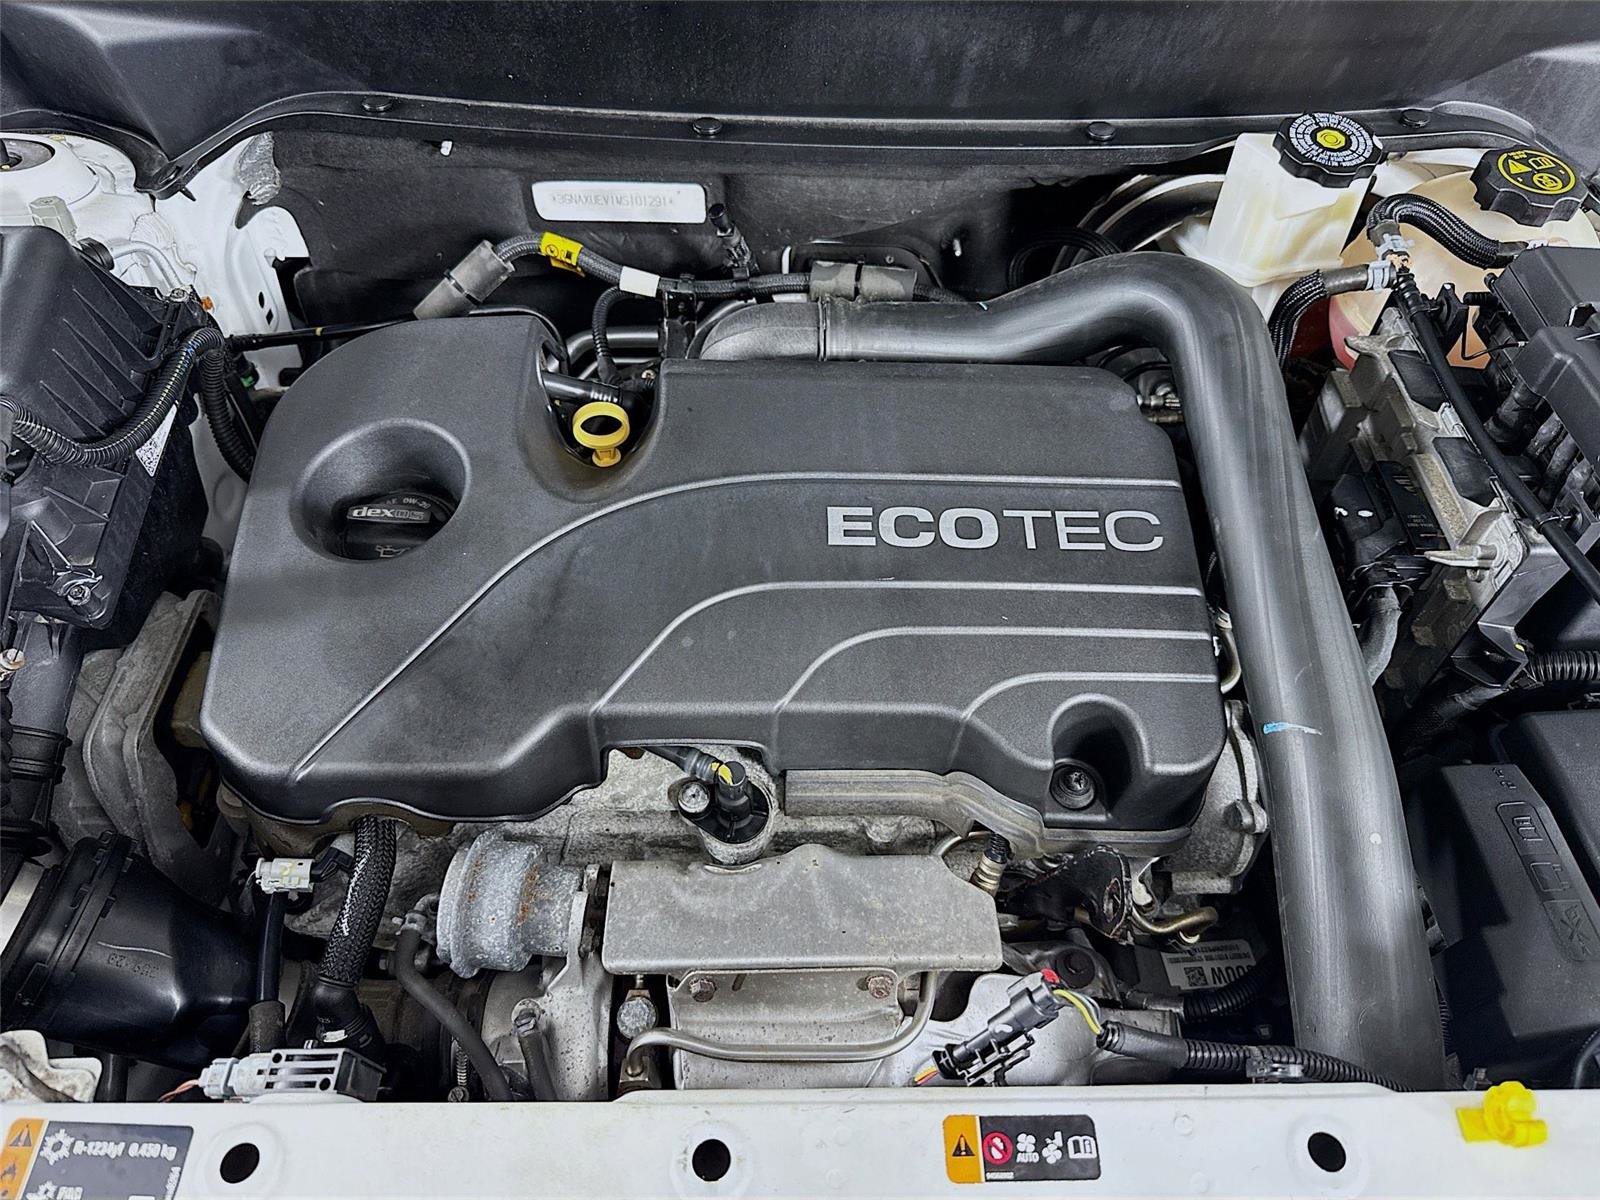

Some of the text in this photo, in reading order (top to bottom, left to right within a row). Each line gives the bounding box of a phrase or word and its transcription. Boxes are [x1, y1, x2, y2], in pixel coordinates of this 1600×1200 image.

[352, 506, 425, 520] dexos
[827, 506, 1163, 551] ECOTEC
[1016, 1152, 1040, 1164] AUTO
